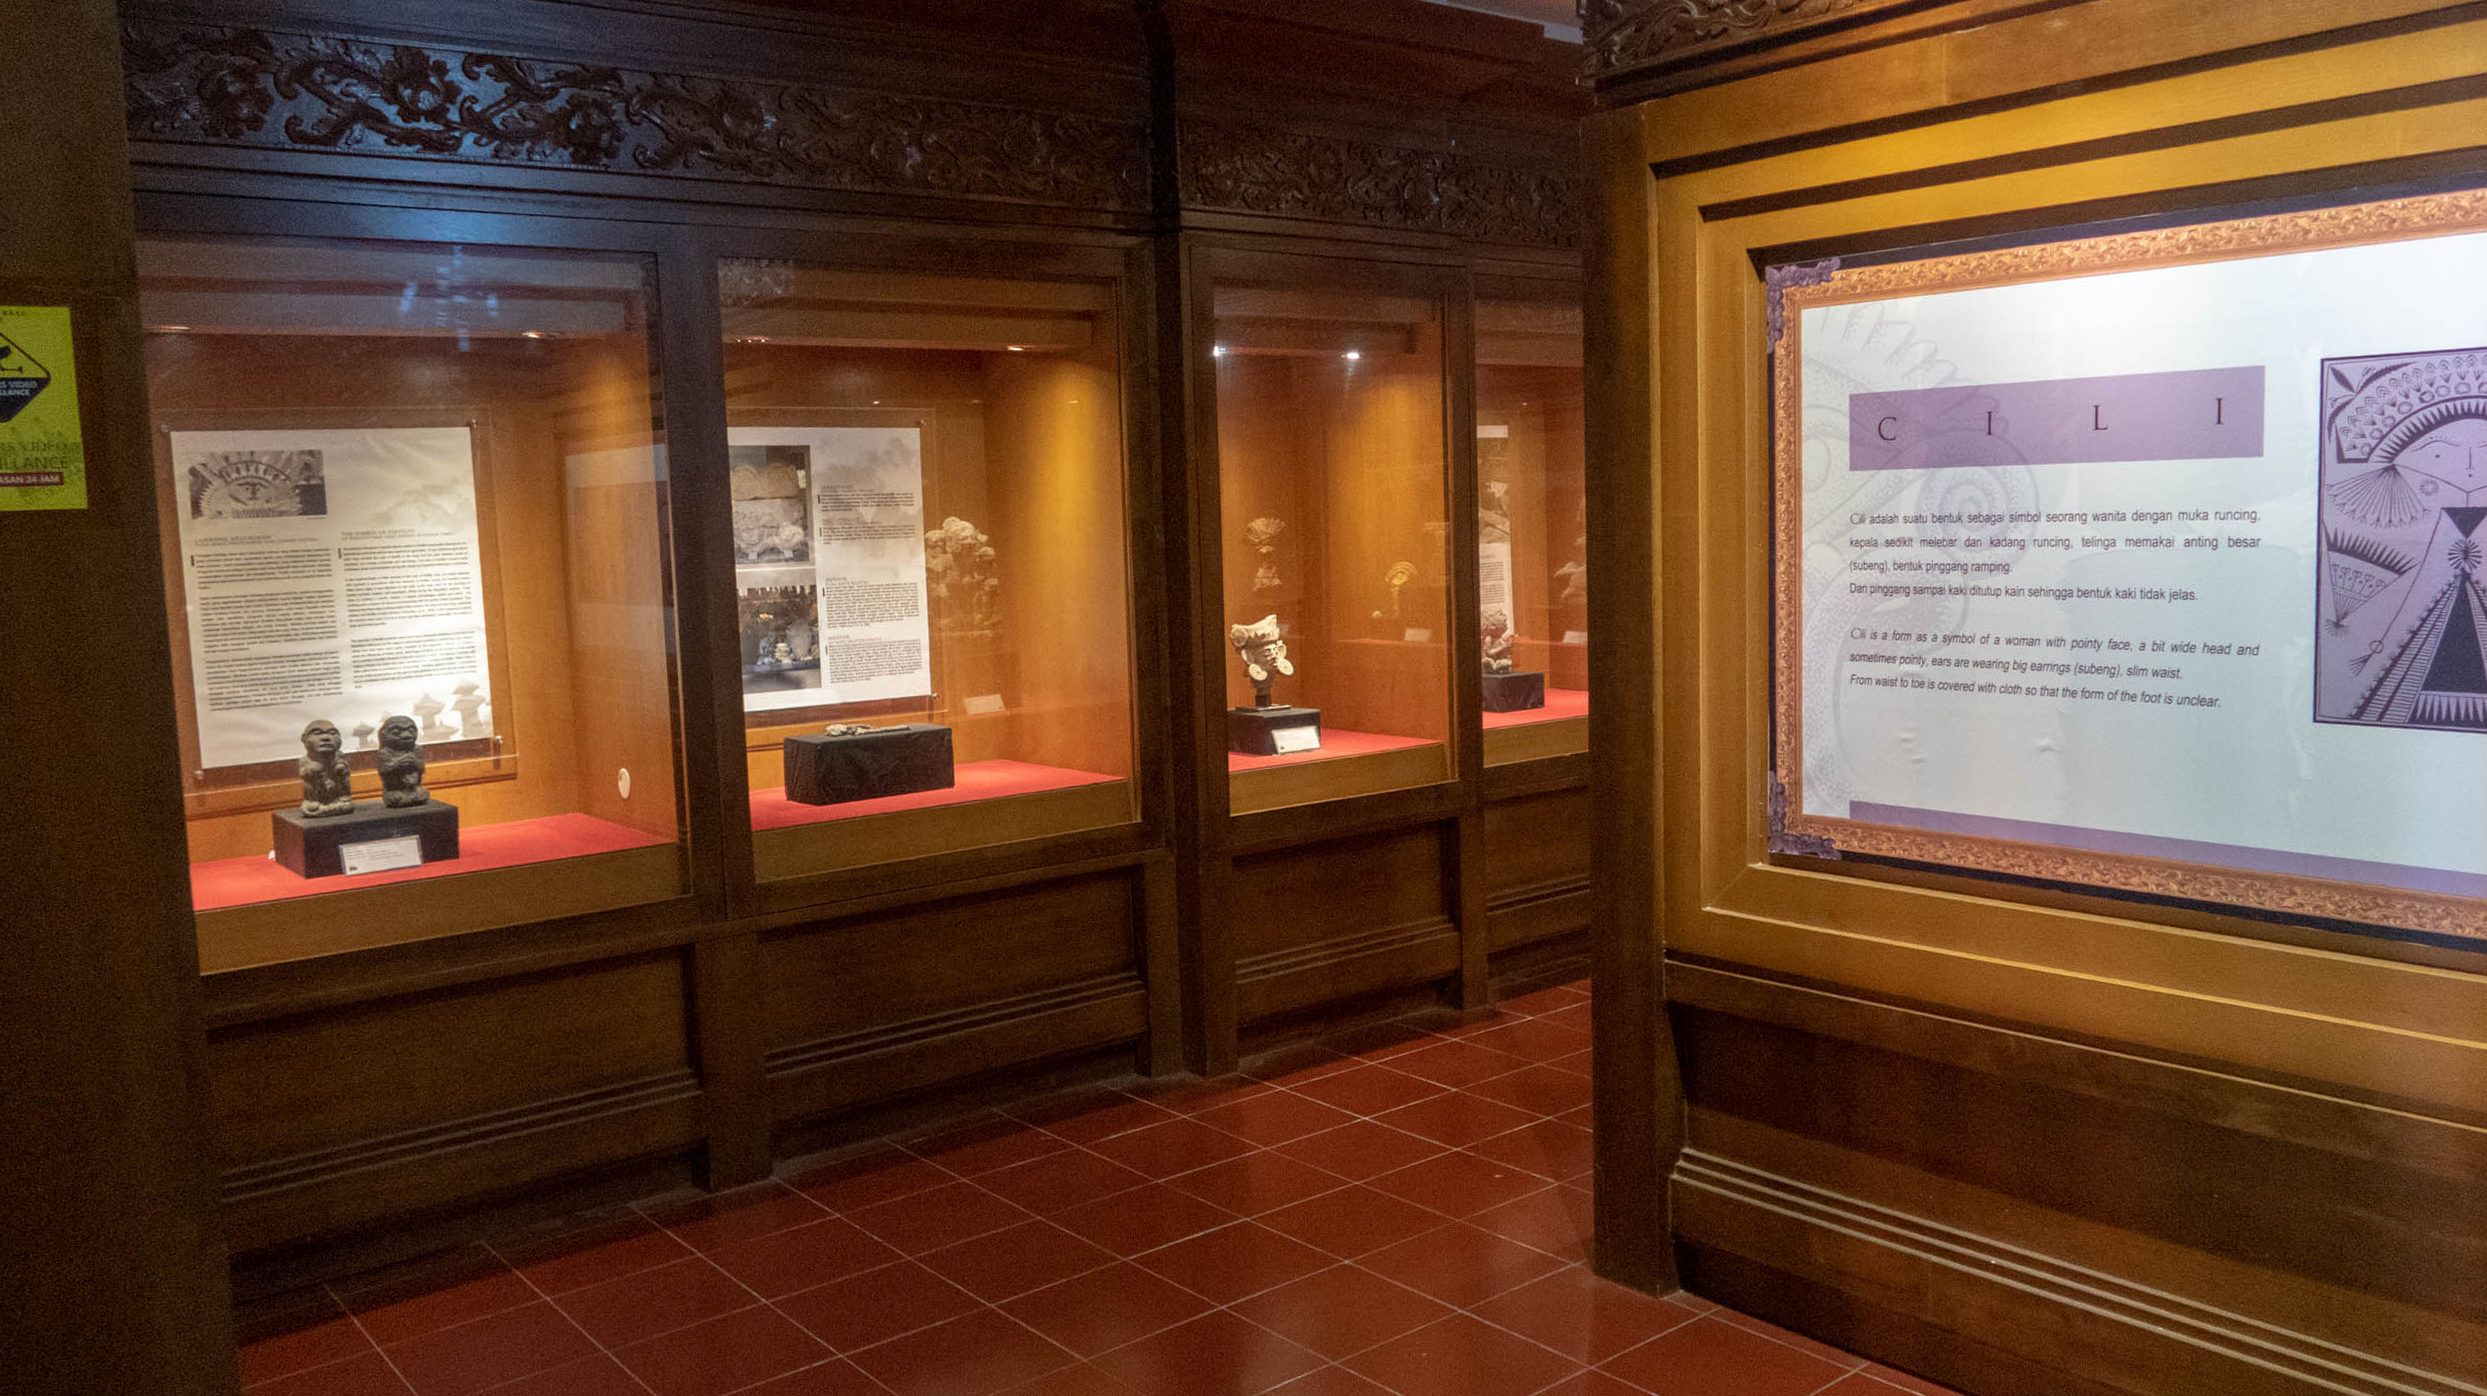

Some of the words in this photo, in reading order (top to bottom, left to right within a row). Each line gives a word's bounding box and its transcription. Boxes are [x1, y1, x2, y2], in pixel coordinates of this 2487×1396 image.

[8, 380, 38, 389] VIDEO
[1869, 513, 1899, 524] adalah
[1903, 514, 1928, 524] suatu
[1931, 512, 1963, 524] bentuk
[1967, 513, 2005, 526] sebagai
[2009, 512, 2041, 523] simbol
[2046, 512, 2087, 524] seorang
[2092, 510, 2127, 522] wanita
[2131, 510, 2173, 524] dengan
[2178, 509, 2209, 522] muka
[1850, 537, 1879, 550] kepala
[1884, 537, 1913, 548] sedikit
[1920, 537, 1958, 548] melebar
[1964, 537, 1982, 548] dan
[1989, 537, 2026, 550] kadang
[2082, 537, 2117, 550] telinga
[2125, 536, 2174, 548] memakai
[2183, 536, 2218, 550] anting
[2227, 536, 2261, 548] besar
[1893, 560, 1923, 571] bentuk
[1925, 561, 1968, 574] pinggang
[1869, 584, 1910, 597] pinggang
[1913, 585, 1946, 598] sampai
[1948, 584, 1968, 595] kaki
[1970, 585, 2001, 597] ditutup
[2004, 586, 2025, 597] kain
[2027, 586, 2073, 600] sehingga
[2077, 587, 2112, 599] bentuk
[2115, 587, 2136, 599] kaki
[2139, 588, 2166, 599] tidak
[2168, 588, 2198, 603] jelas.
[1850, 628, 1866, 639] Cili
[1870, 630, 1878, 640] is
[1881, 632, 1888, 640] a
[1892, 630, 1912, 641] form
[1916, 633, 1927, 642] as
[1931, 633, 1938, 642] a
[1942, 632, 1975, 646] symbol
[1980, 634, 1991, 645] of
[1994, 636, 2000, 645] a
[2005, 637, 2041, 647] woman
[2046, 637, 2066, 648] with
[2070, 638, 2102, 651] pointy
[2138, 643, 2146, 651] a
[2151, 640, 2165, 652] bit
[2171, 642, 2196, 653] wide
[2202, 642, 2232, 655] head
[2237, 644, 2260, 656] and
[1849, 652, 1897, 664] sometimes
[1931, 657, 1952, 667] ears
[1954, 658, 1970, 668] are
[1972, 658, 2010, 673] wearing
[2012, 659, 2027, 673] big
[2126, 665, 2148, 677] slim
[1850, 674, 1873, 686] From
[1875, 676, 1898, 688] waist
[1900, 677, 1909, 688] to
[1911, 678, 1925, 689] toe
[1927, 679, 1936, 690] is
[1937, 680, 1974, 693] covered
[1977, 681, 1996, 694] with
[1999, 682, 2022, 695] cloth
[2025, 686, 2037, 696] so
[2040, 685, 2059, 697] that
[2062, 687, 2078, 699] the
[2081, 688, 2104, 700] form
[2107, 689, 2119, 701] of
[2121, 690, 2137, 702] the
[2141, 691, 2161, 704] foot
[2164, 692, 2173, 705] is
